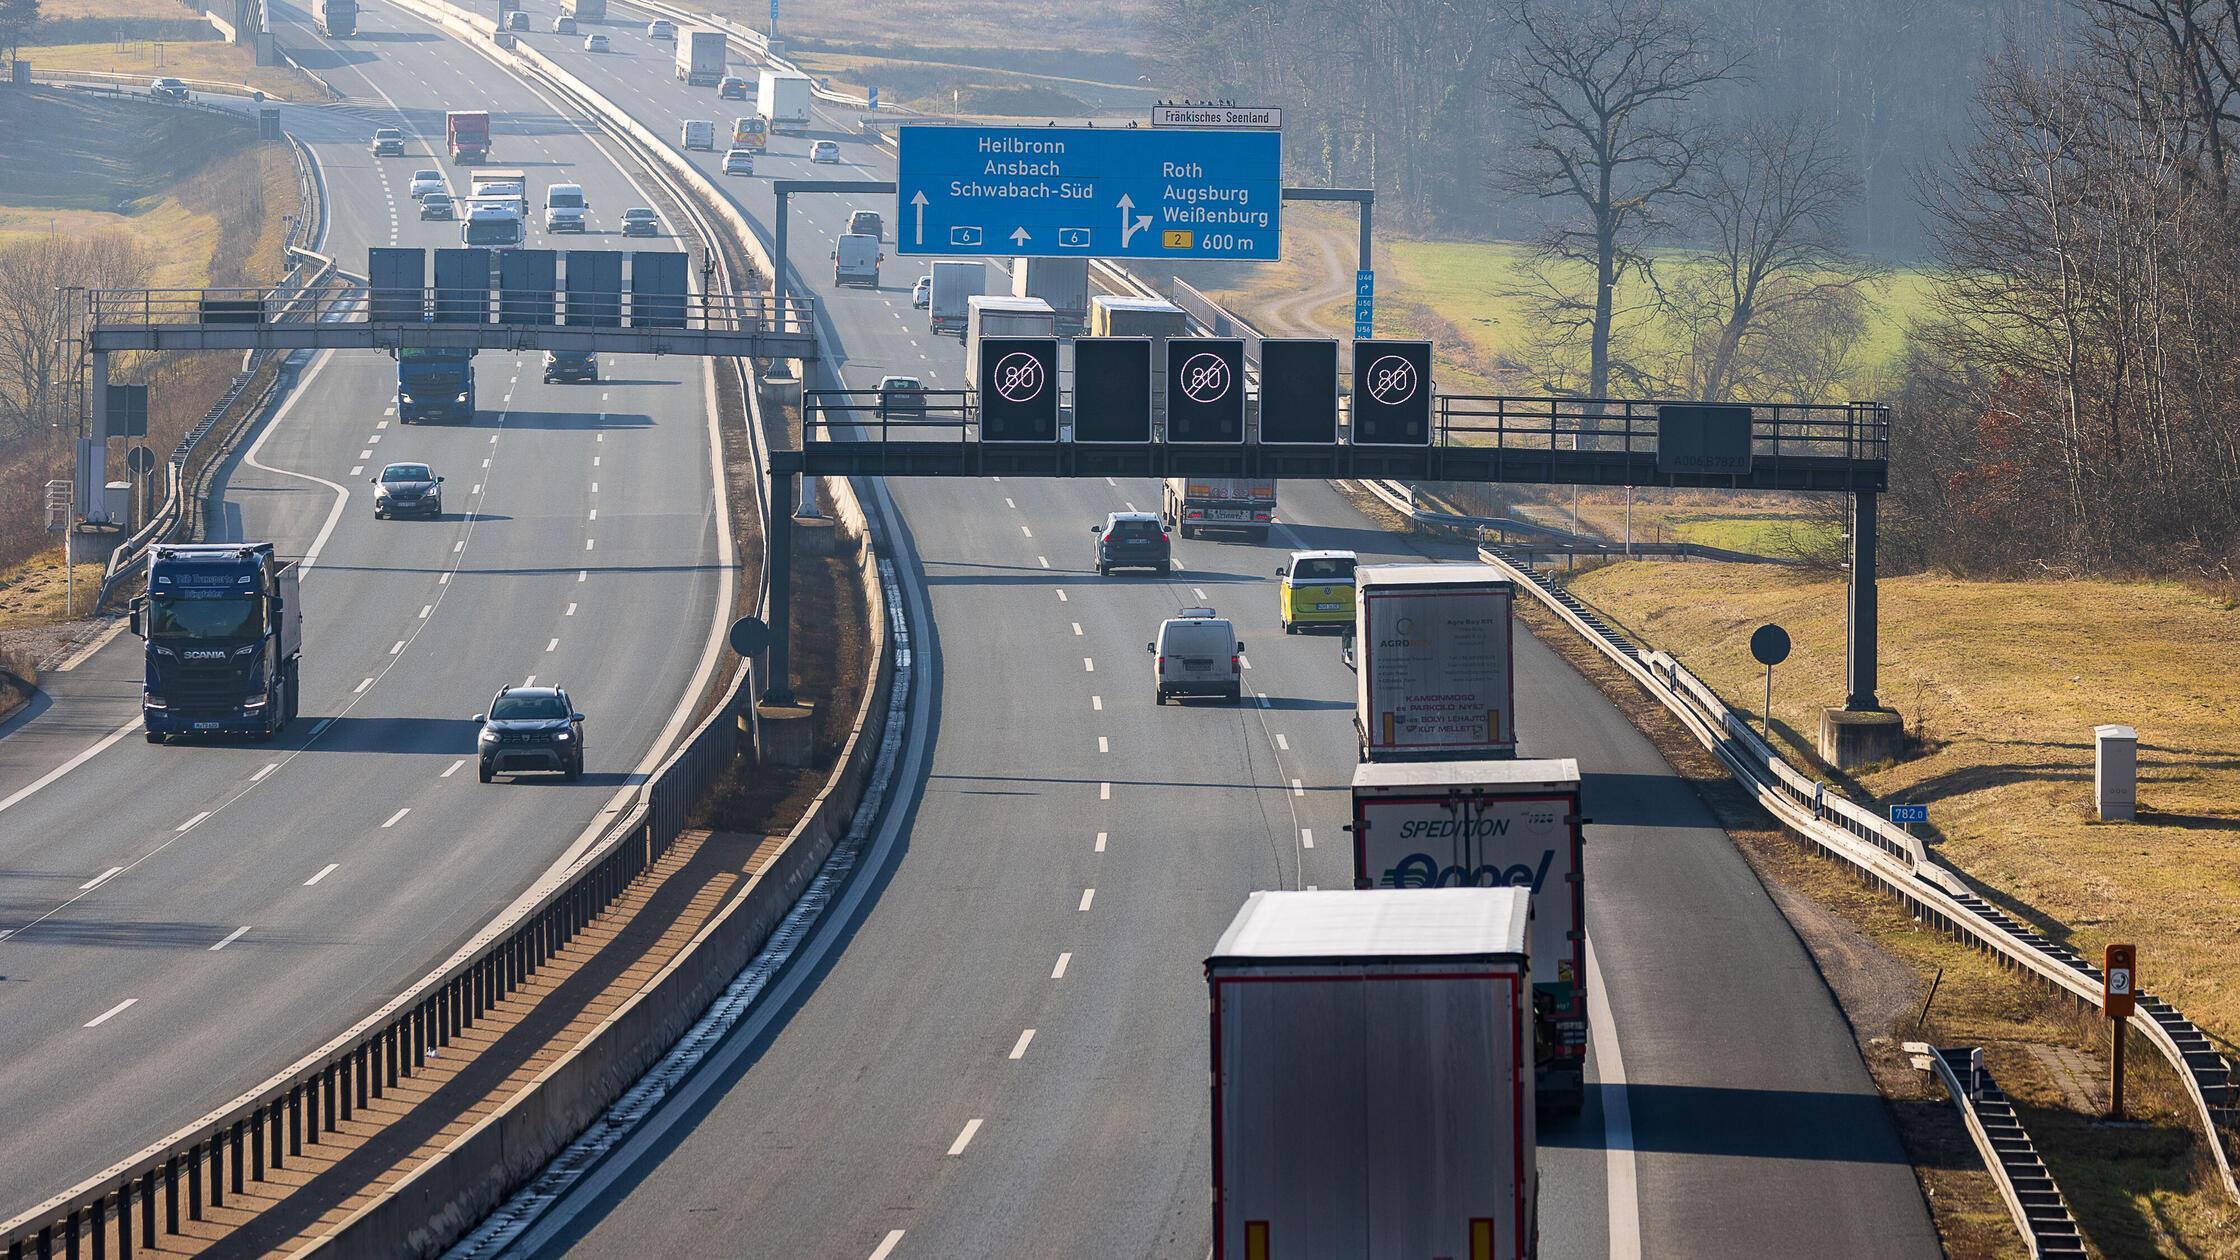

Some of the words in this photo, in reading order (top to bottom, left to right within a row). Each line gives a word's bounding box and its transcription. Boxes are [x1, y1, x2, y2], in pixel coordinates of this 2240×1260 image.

[1165, 110, 1221, 122] Fränkisches
[1226, 111, 1269, 123] Seenland
[978, 137, 1065, 153] Heilbronn
[984, 159, 1060, 176] Ansbach
[1163, 161, 1202, 178] Roth
[950, 181, 1093, 199] Schwabach-Süd
[1163, 184, 1248, 205] Augsburg
[1163, 206, 1268, 228] Weißenburg
[962, 230, 970, 242] 6
[1071, 232, 1079, 243] 6
[1174, 233, 1182, 246] 2
[1202, 234, 1233, 250] 600
[1237, 238, 1254, 250] m
[1006, 366, 1034, 388] 80
[1192, 367, 1220, 389] 80
[1378, 369, 1407, 391] 80
[183, 650, 226, 660] SCANIA
[1400, 818, 1510, 839] SPEDITION
